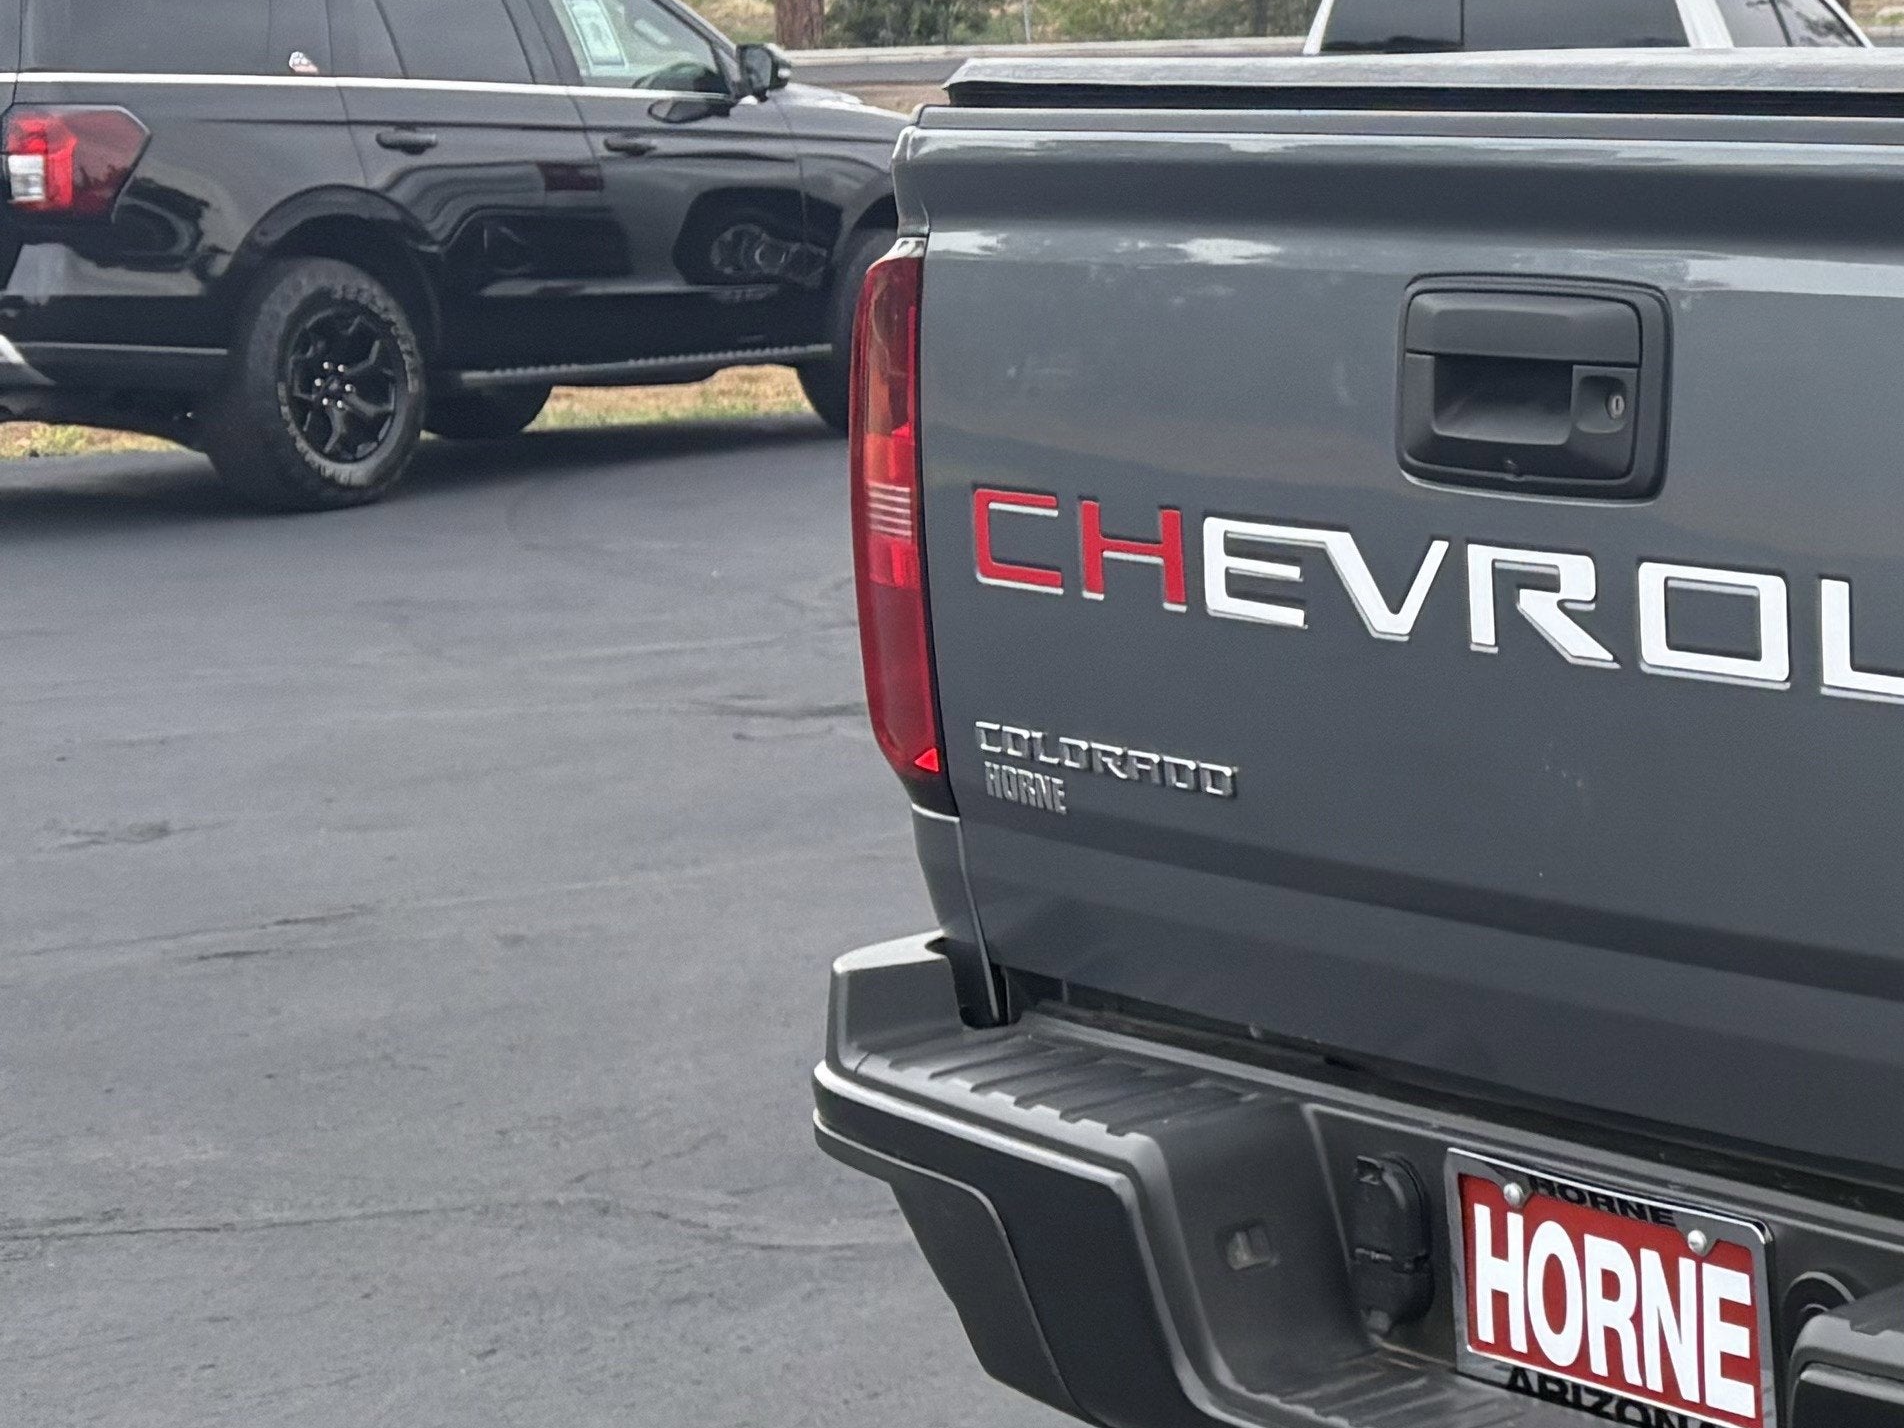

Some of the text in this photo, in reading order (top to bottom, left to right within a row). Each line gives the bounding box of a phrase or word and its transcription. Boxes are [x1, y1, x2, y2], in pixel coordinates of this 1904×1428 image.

[975, 721, 1239, 798] COLORADO
[984, 760, 1067, 815] HORNE
[1524, 1174, 1678, 1229] HORNE
[1473, 1202, 1757, 1420] HORNE
